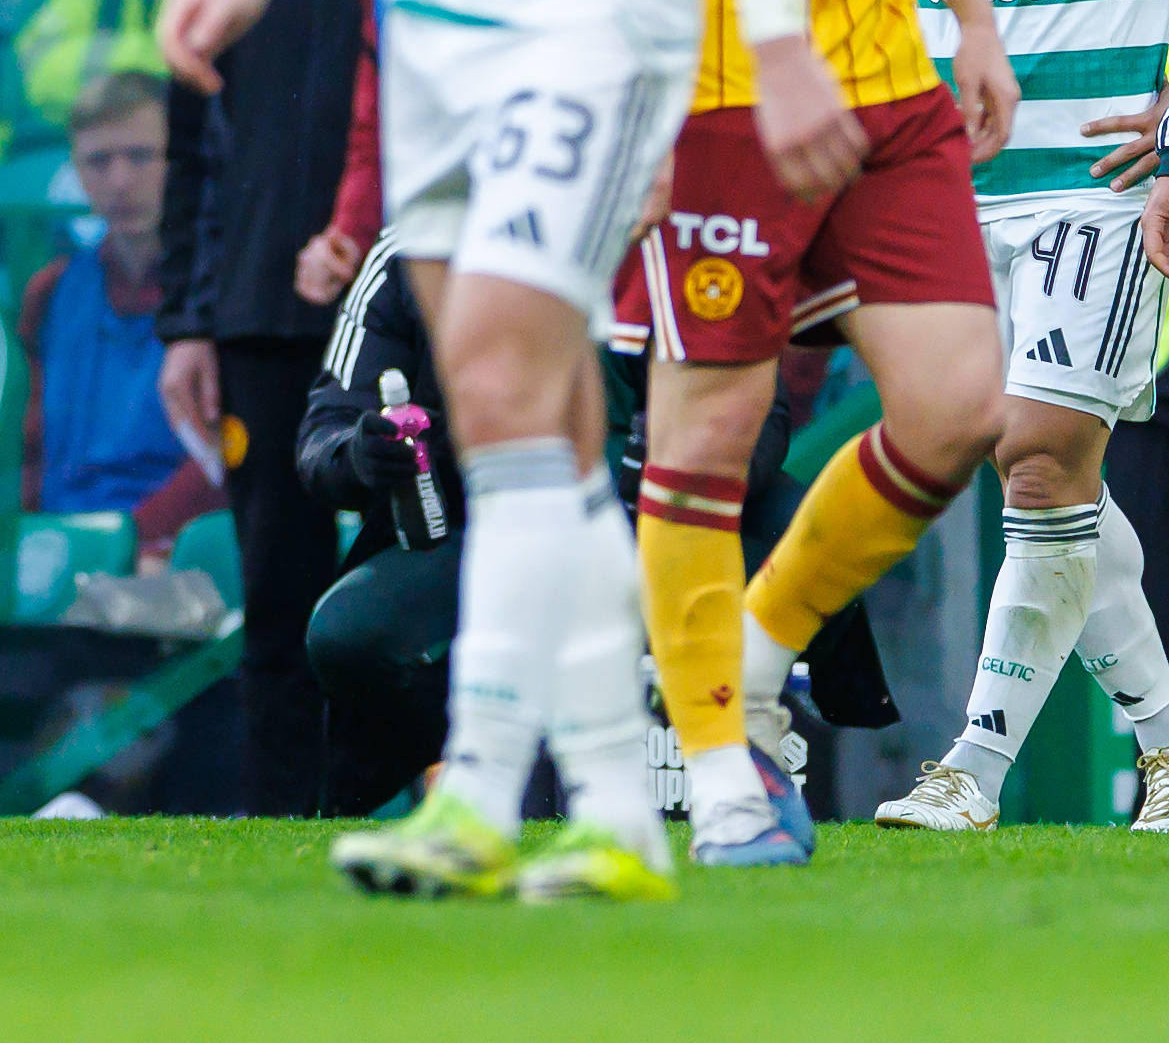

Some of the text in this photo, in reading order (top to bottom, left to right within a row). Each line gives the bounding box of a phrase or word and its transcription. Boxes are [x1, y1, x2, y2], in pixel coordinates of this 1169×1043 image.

[669, 212, 770, 257] TCL
[1032, 221, 1103, 302] 41
[982, 656, 1036, 682] CELTIC
